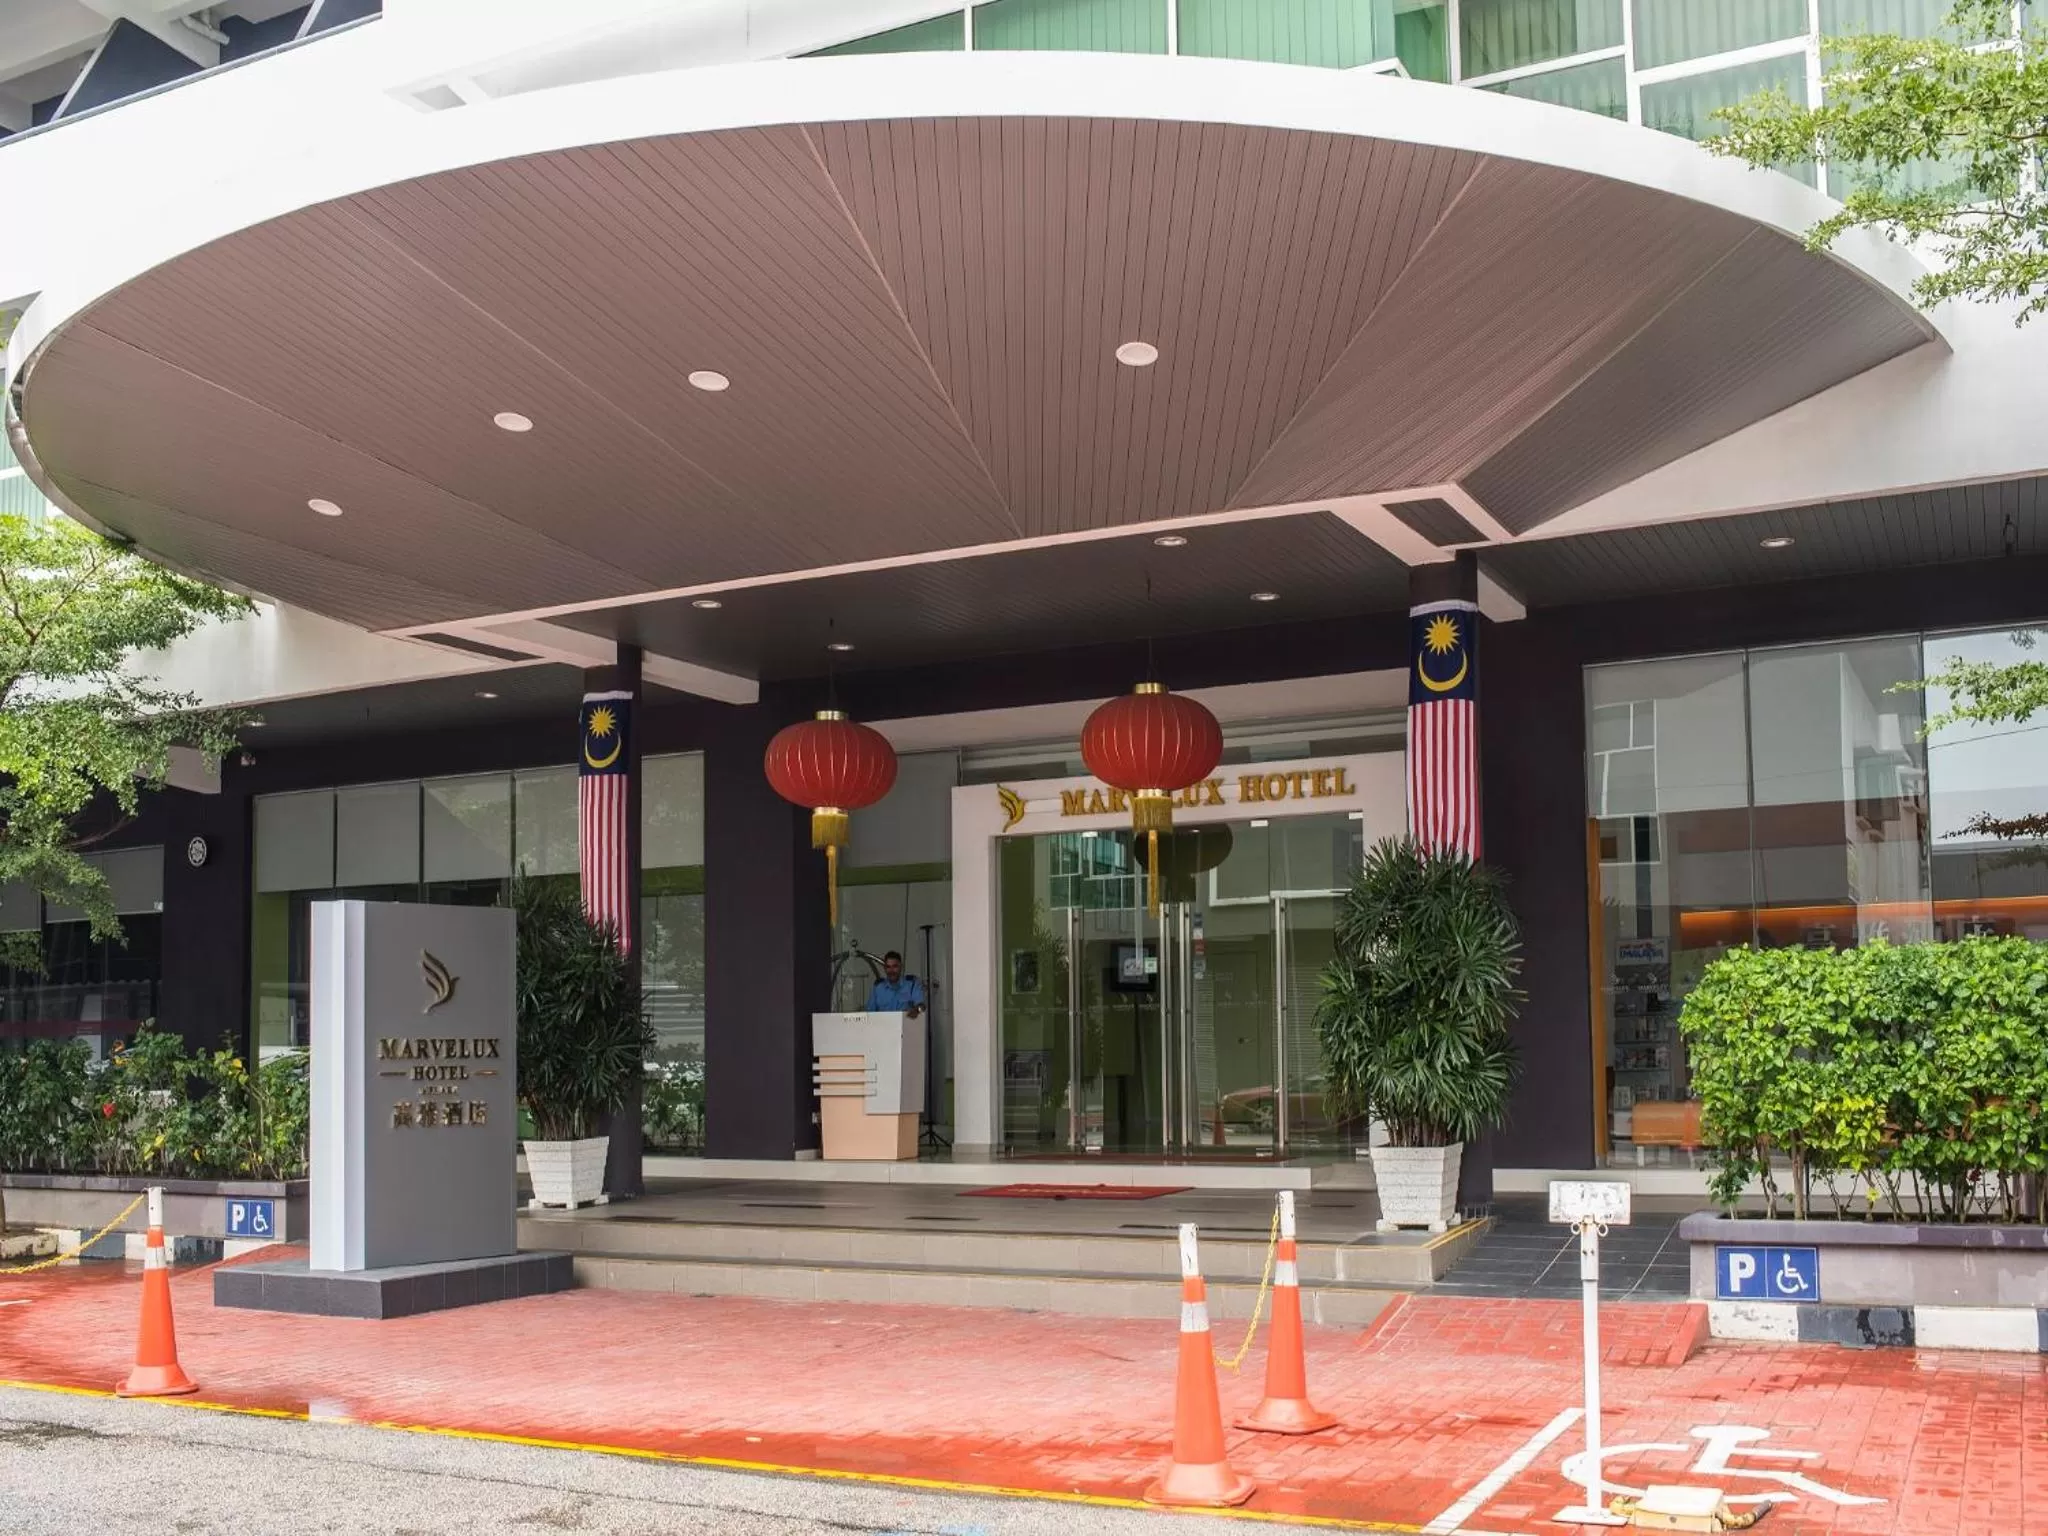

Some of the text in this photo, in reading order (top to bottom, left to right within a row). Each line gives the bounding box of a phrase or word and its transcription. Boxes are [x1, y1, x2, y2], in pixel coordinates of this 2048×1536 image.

[1238, 767, 1355, 804] HOTEL
[378, 1037, 500, 1060] MARVELUX
[411, 1065, 469, 1081] HOTEL
[231, 1203, 245, 1231] P
[1729, 1252, 1756, 1293] P
